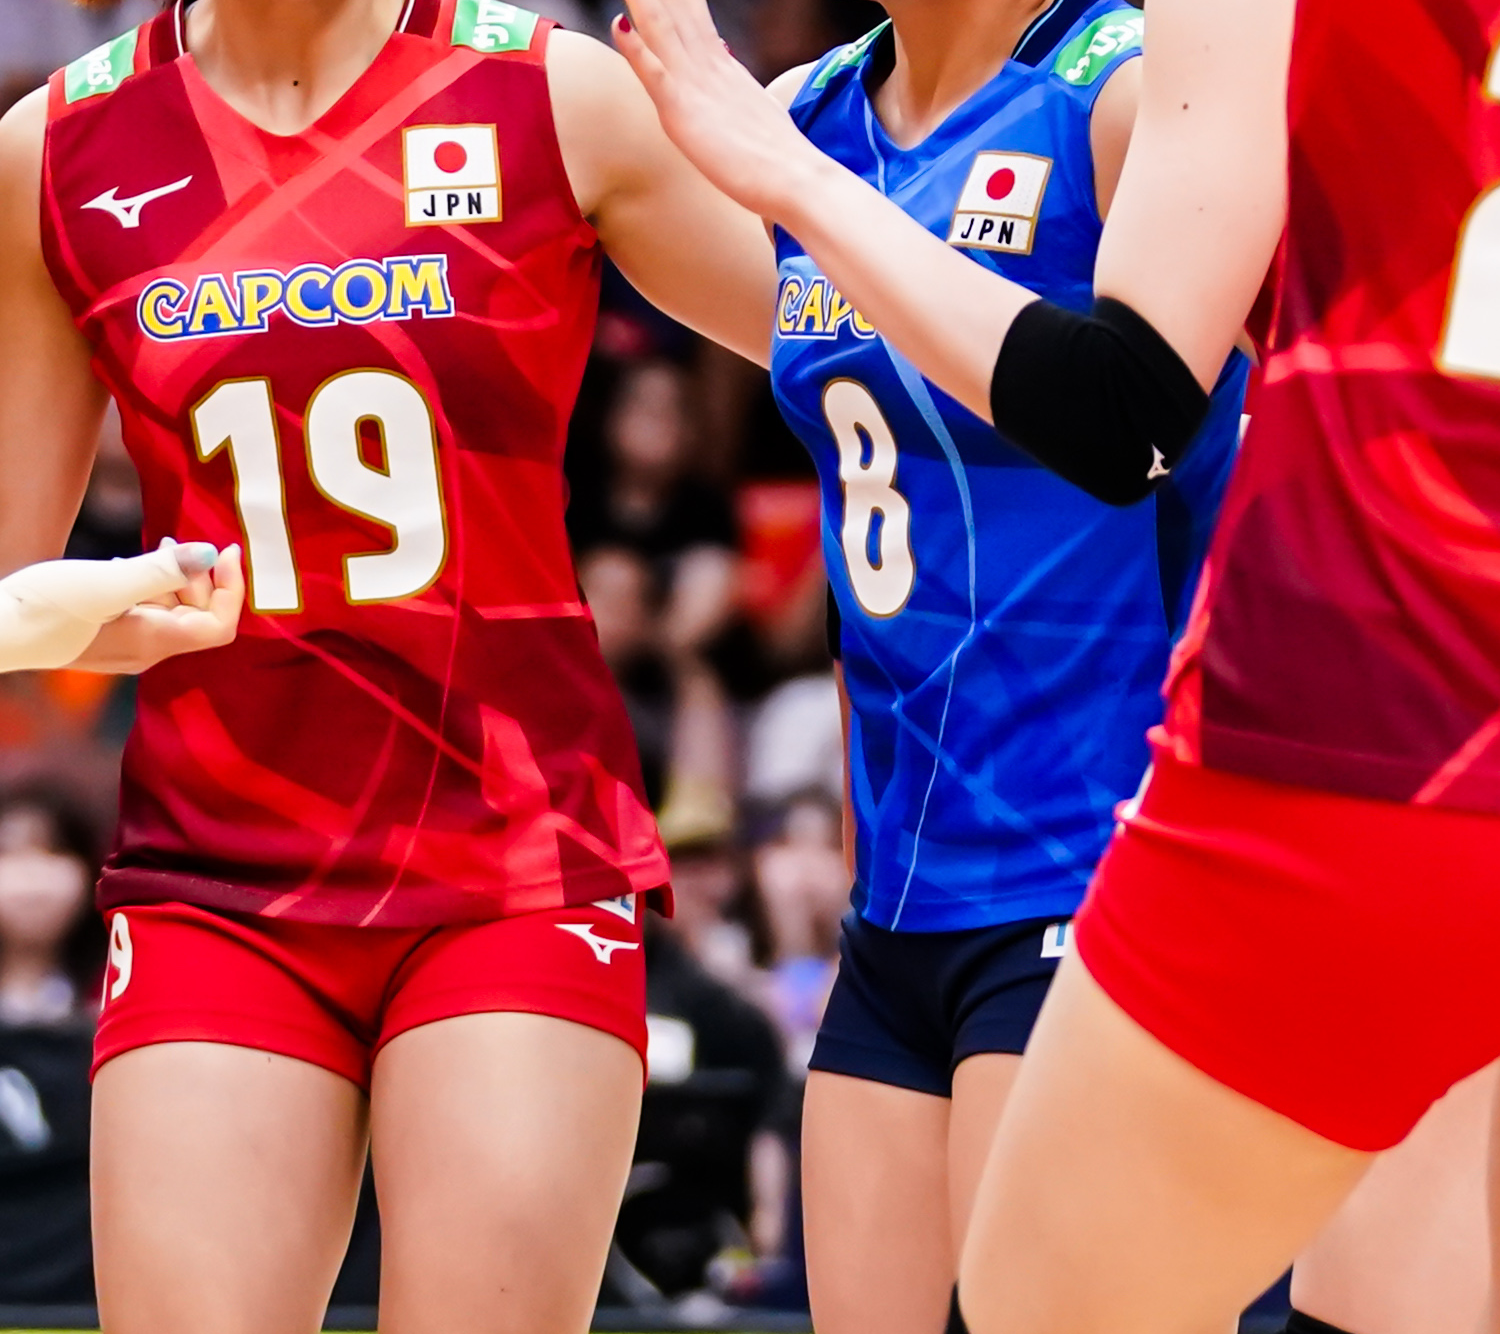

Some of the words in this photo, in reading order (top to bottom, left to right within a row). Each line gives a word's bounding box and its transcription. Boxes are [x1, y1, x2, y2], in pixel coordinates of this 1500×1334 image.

[423, 192, 483, 218] JPN
[961, 217, 1015, 246] JPN
[138, 253, 455, 343] CAPCOM
[777, 275, 876, 340] CAP
[190, 367, 451, 615] 19
[820, 376, 916, 620] 8
